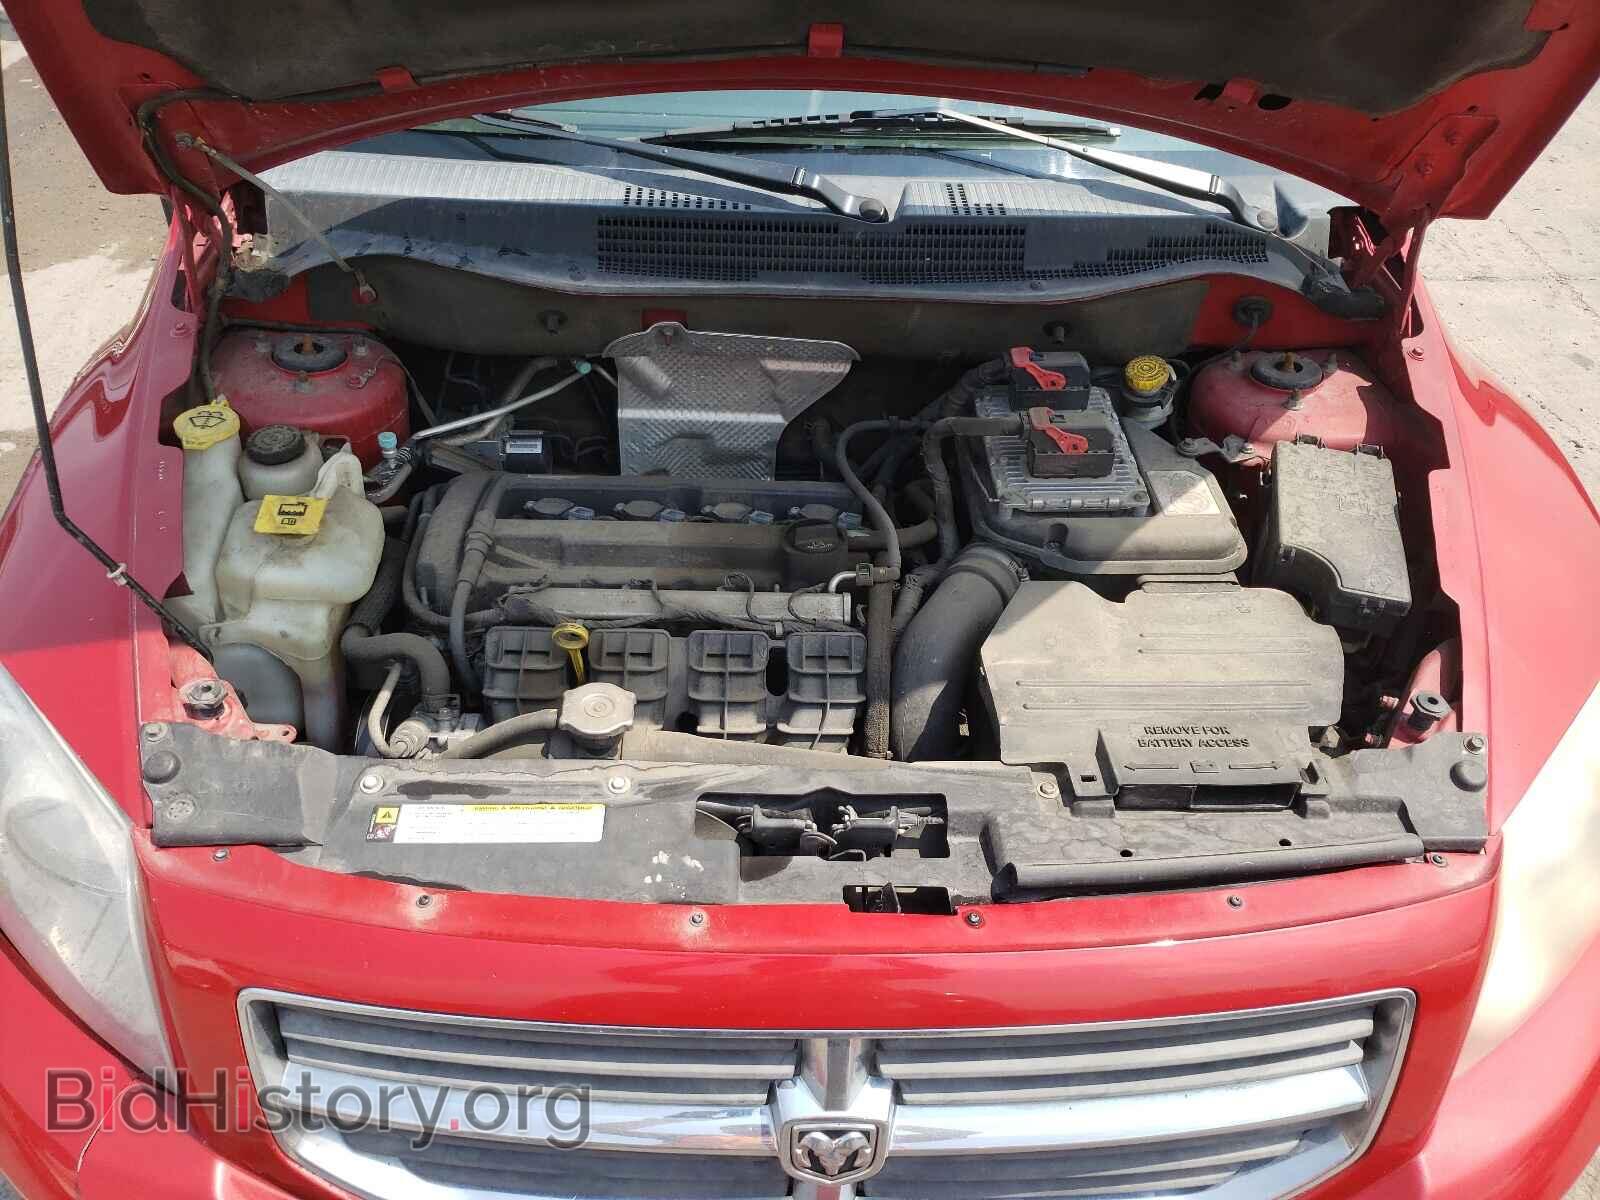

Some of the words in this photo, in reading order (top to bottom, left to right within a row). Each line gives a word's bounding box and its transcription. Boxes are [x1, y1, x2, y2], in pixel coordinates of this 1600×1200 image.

[1143, 725, 1200, 735] REMOVE
[1202, 725, 1231, 735] FOR
[1137, 738, 1193, 748] BATTERY
[1198, 738, 1250, 748] ACCESS
